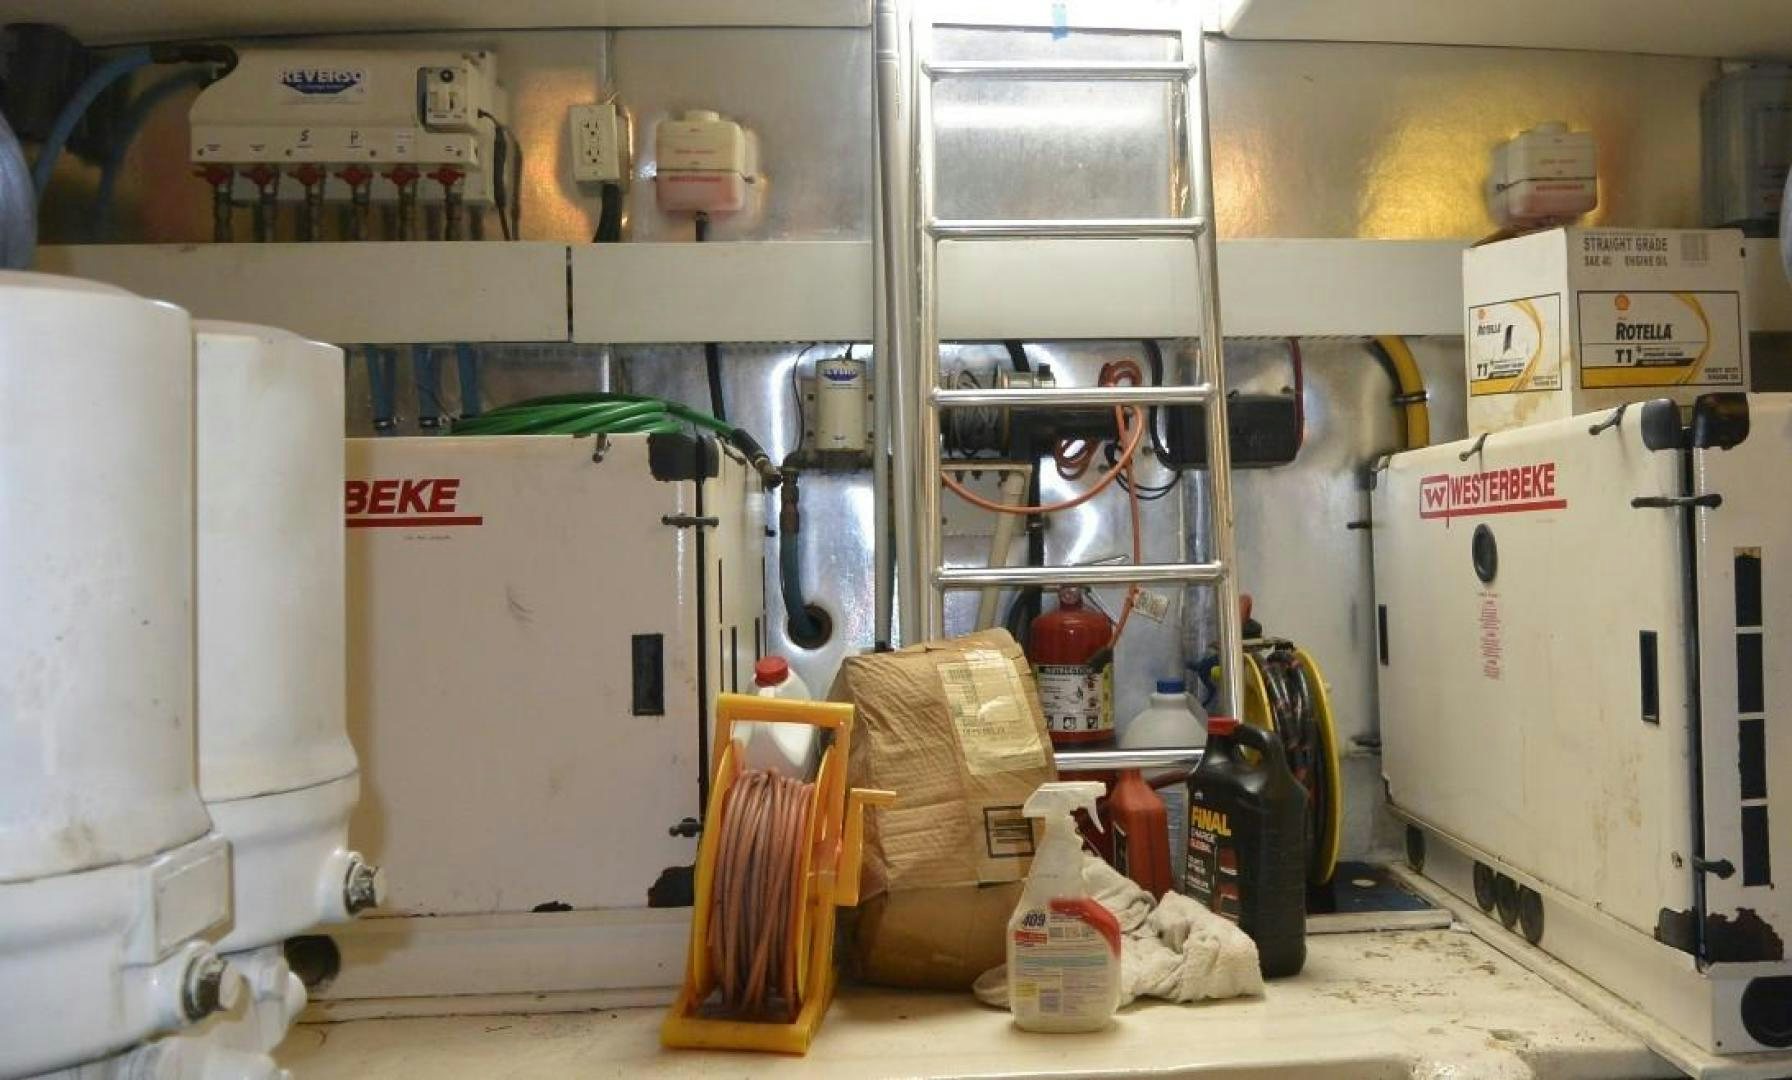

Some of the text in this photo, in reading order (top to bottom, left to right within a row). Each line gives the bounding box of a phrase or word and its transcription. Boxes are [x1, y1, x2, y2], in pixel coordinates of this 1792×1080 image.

[1584, 237, 1668, 252] STRAIGHT GRADE
[1616, 322, 1673, 340] ROTELLA
[1450, 463, 1555, 506] WESTERBEKE
[1192, 805, 1232, 837] FINAL
